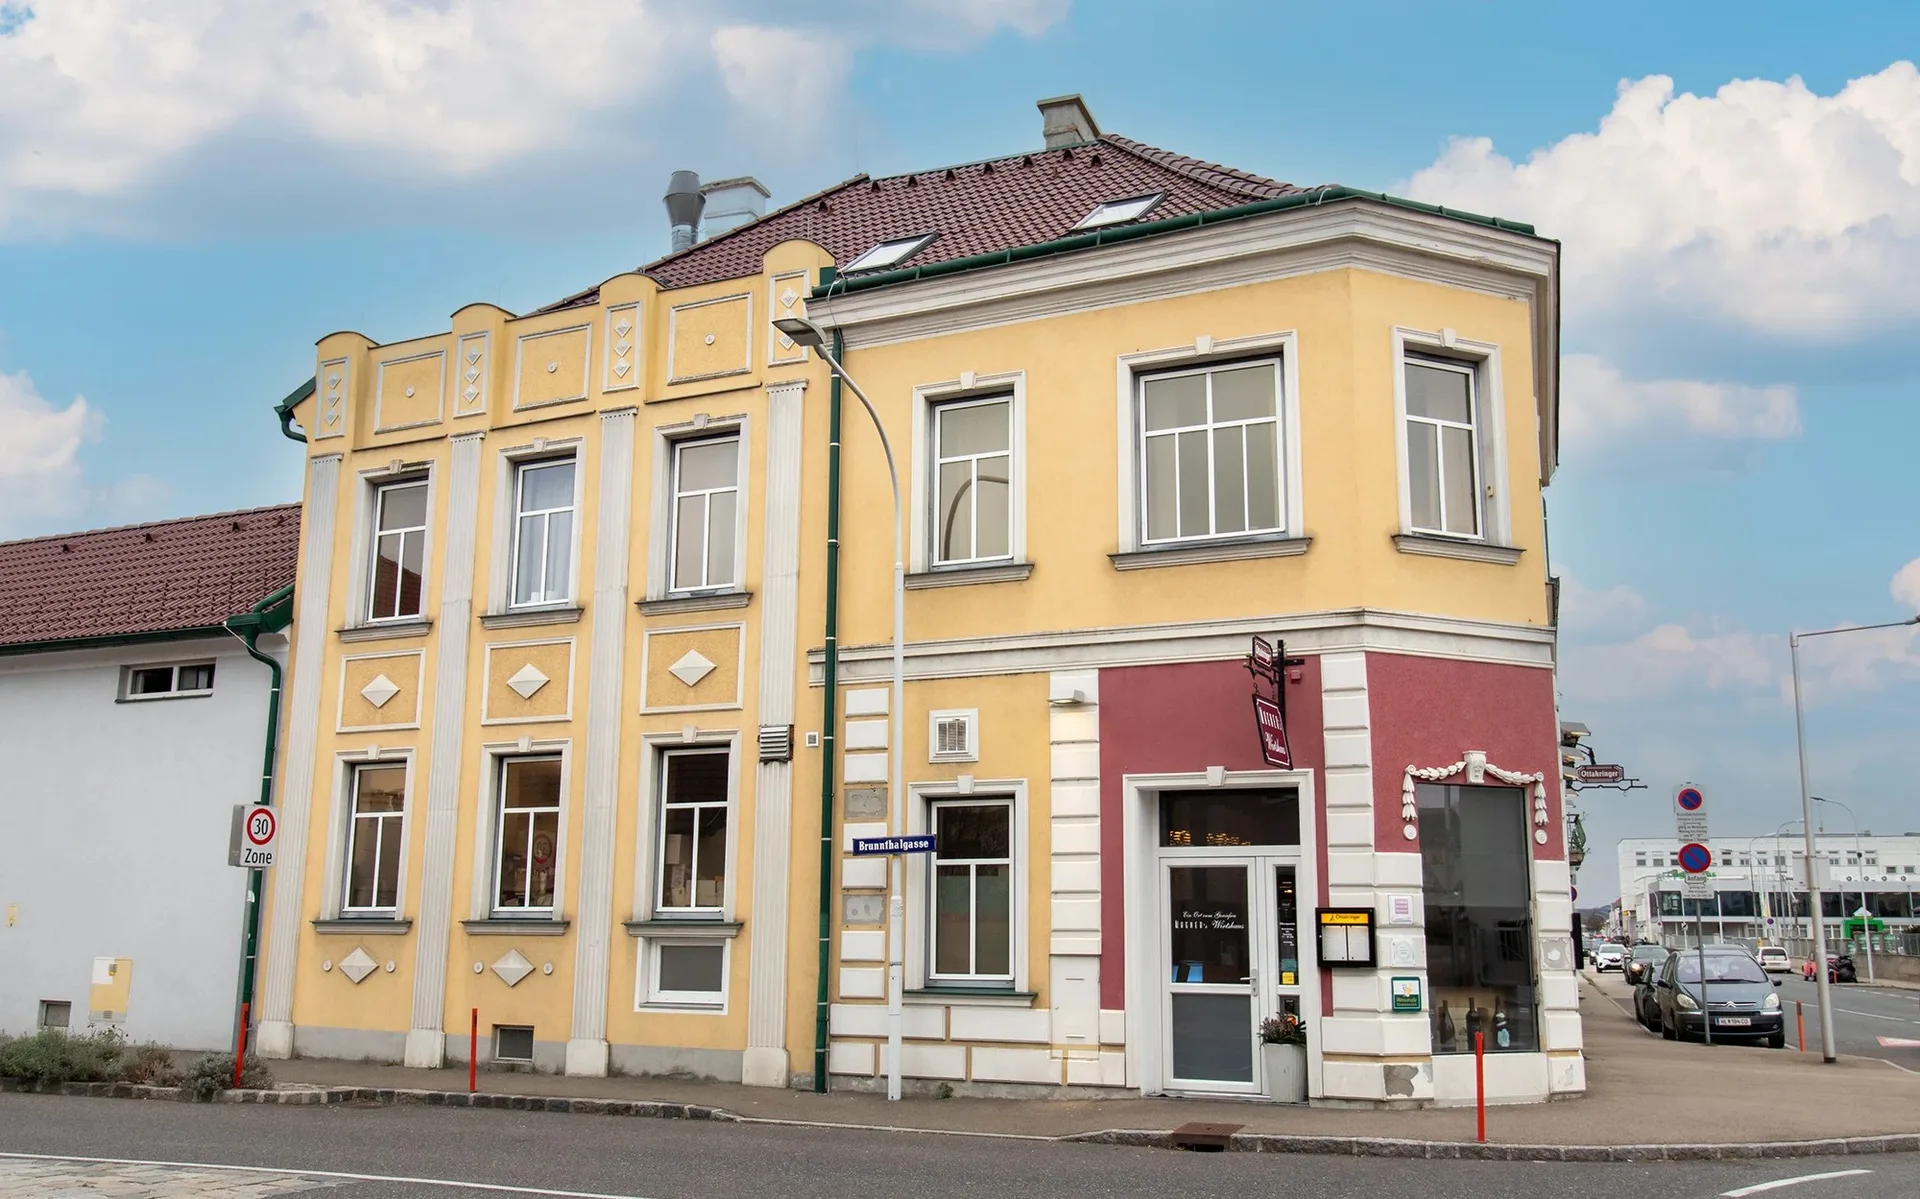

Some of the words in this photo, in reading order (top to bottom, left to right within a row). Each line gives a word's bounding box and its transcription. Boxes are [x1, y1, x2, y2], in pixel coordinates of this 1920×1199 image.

[1580, 769, 1619, 779] Ottakringer
[254, 818, 269, 835] 30
[858, 838, 929, 852] Brunnthalgasse
[245, 847, 273, 865] Zone
[1212, 919, 1244, 929] Wirtshaus
